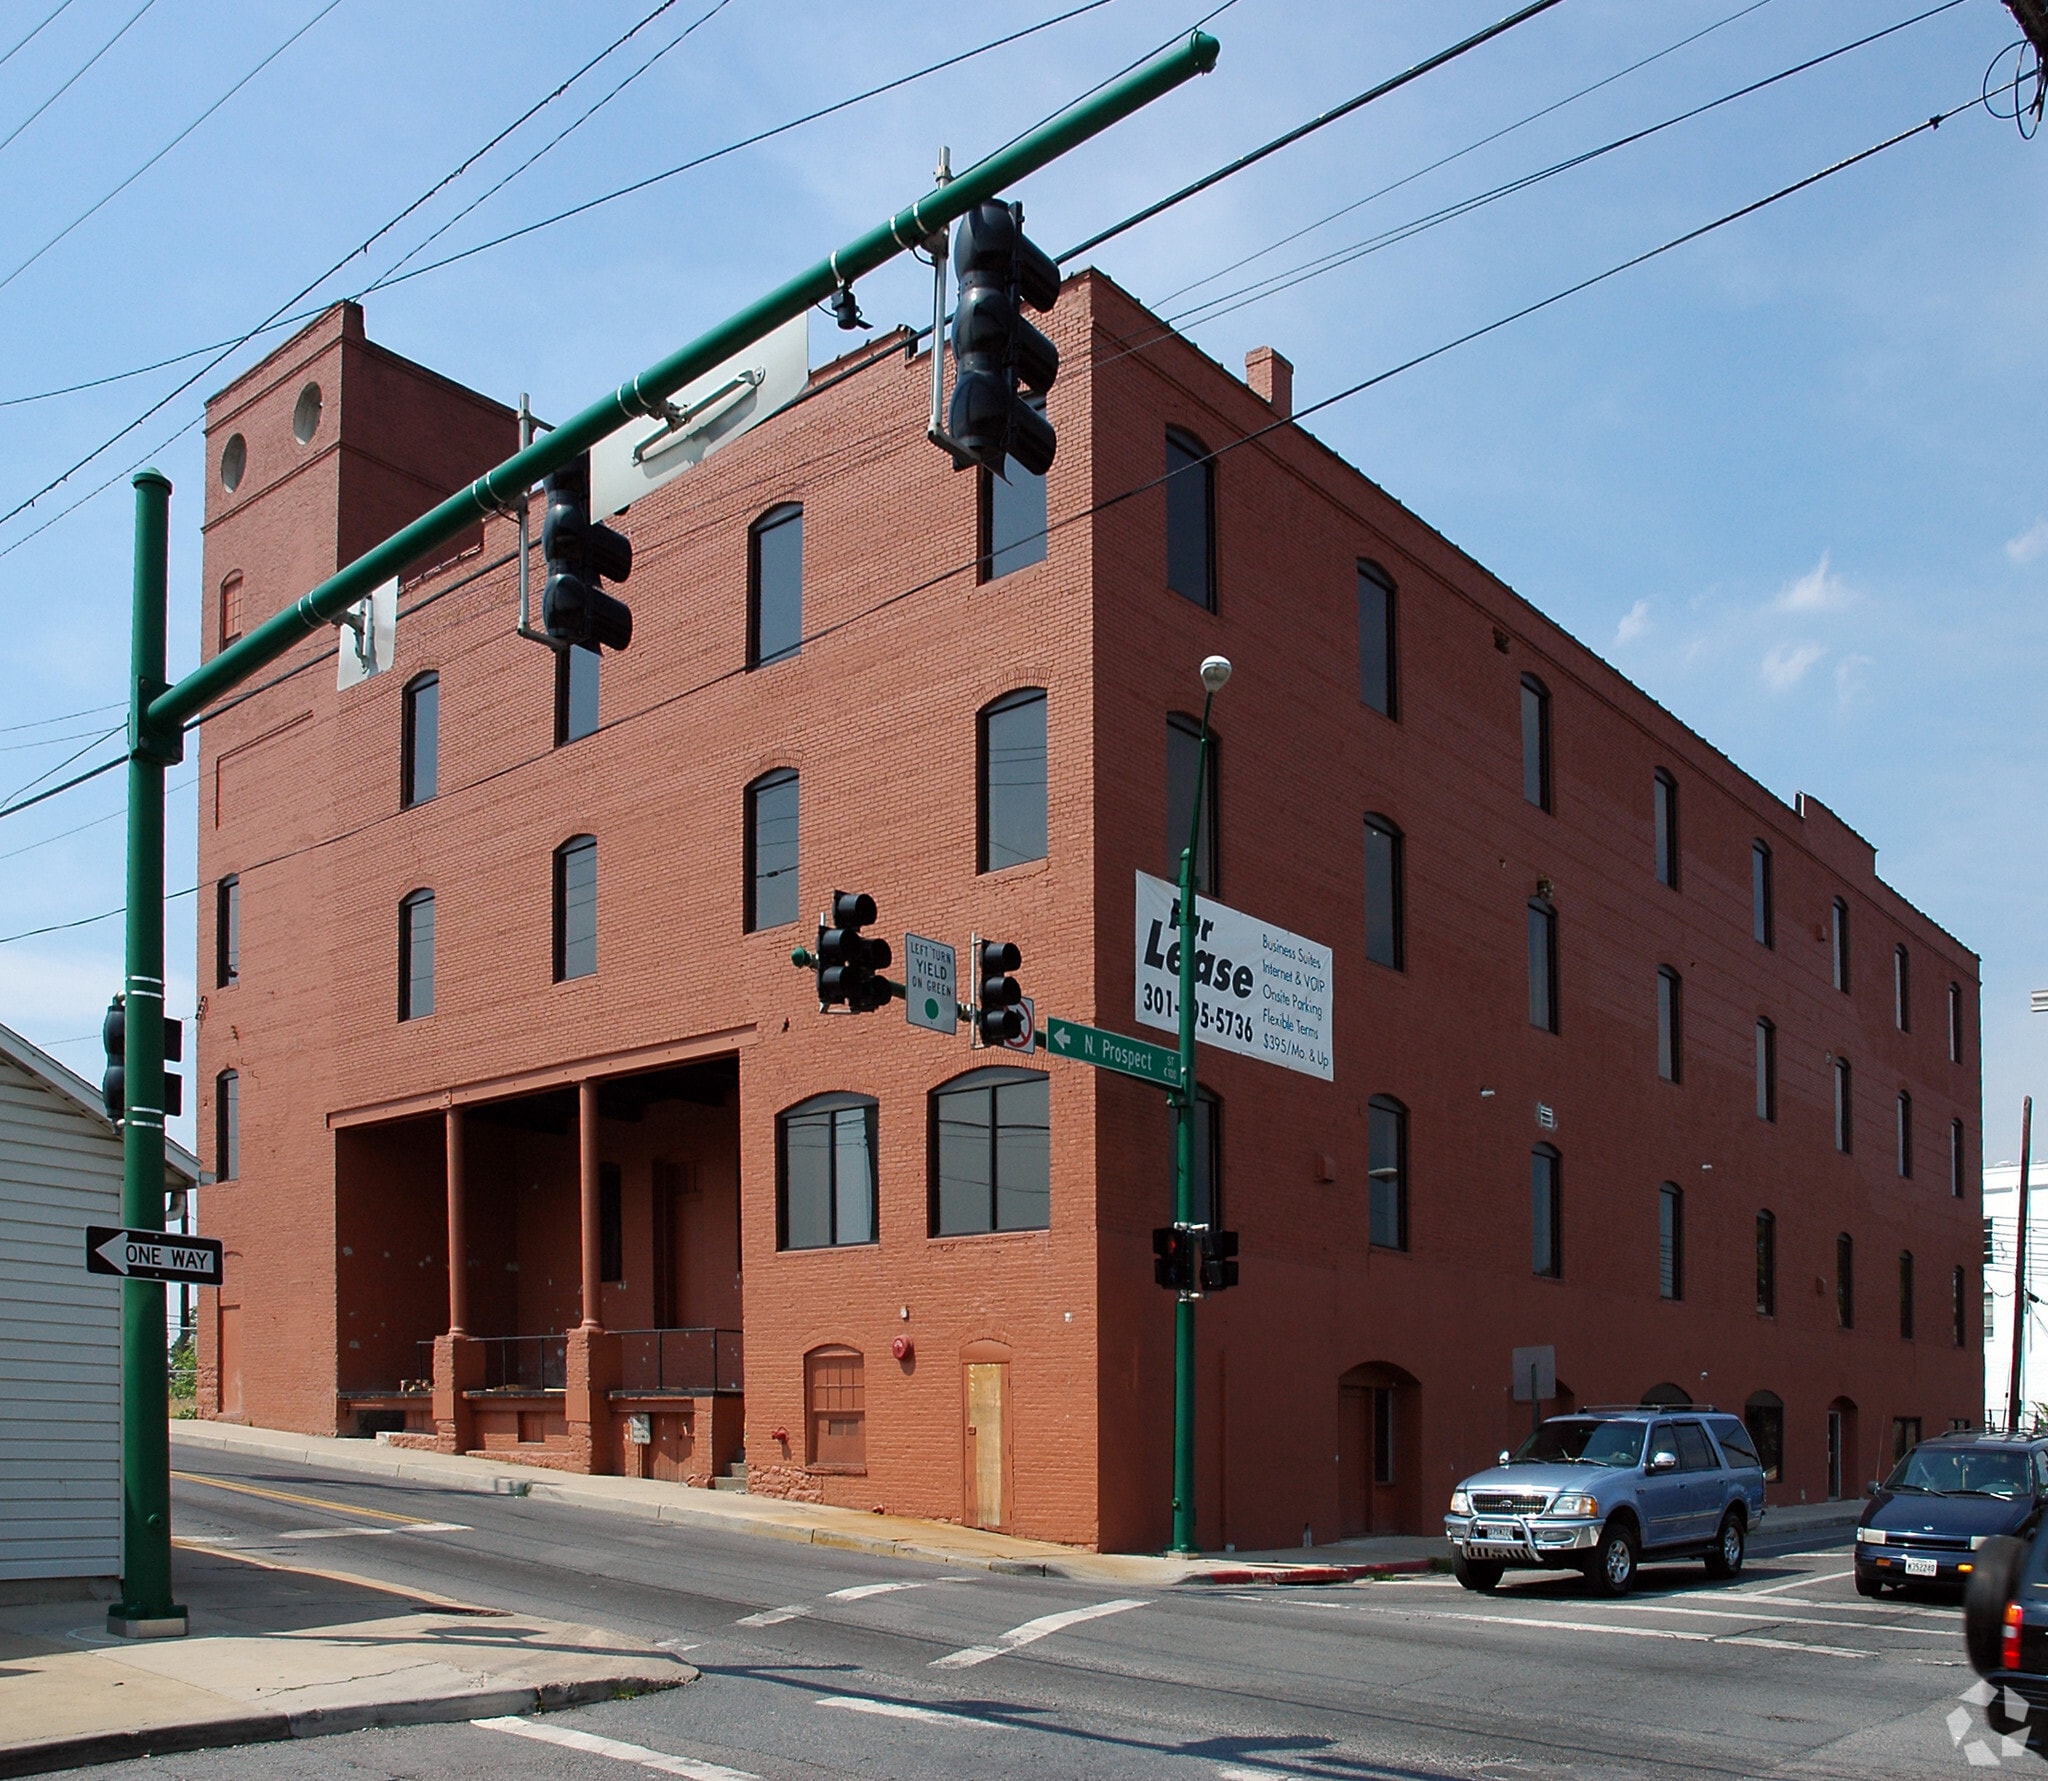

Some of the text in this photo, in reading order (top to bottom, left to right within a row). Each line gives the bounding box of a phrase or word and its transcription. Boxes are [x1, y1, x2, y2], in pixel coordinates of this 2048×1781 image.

[910, 941, 951, 964] LEFT TURN
[1144, 918, 1254, 998] Lease
[1263, 933, 1321, 969] Business Suites
[912, 975, 952, 997] ON GREEN
[916, 958, 947, 981] YIELD
[1263, 959, 1326, 992] Internet & VOIP
[1263, 983, 1323, 1022] Onsite Parking
[1263, 1007, 1319, 1040] Flexible Terms
[1084, 1034, 1152, 1071] N. Prospect
[1167, 1055, 1175, 1067] ST
[1263, 1033, 1329, 1070] $395/Mo. & Up
[126, 1244, 208, 1270] ONE WAY
